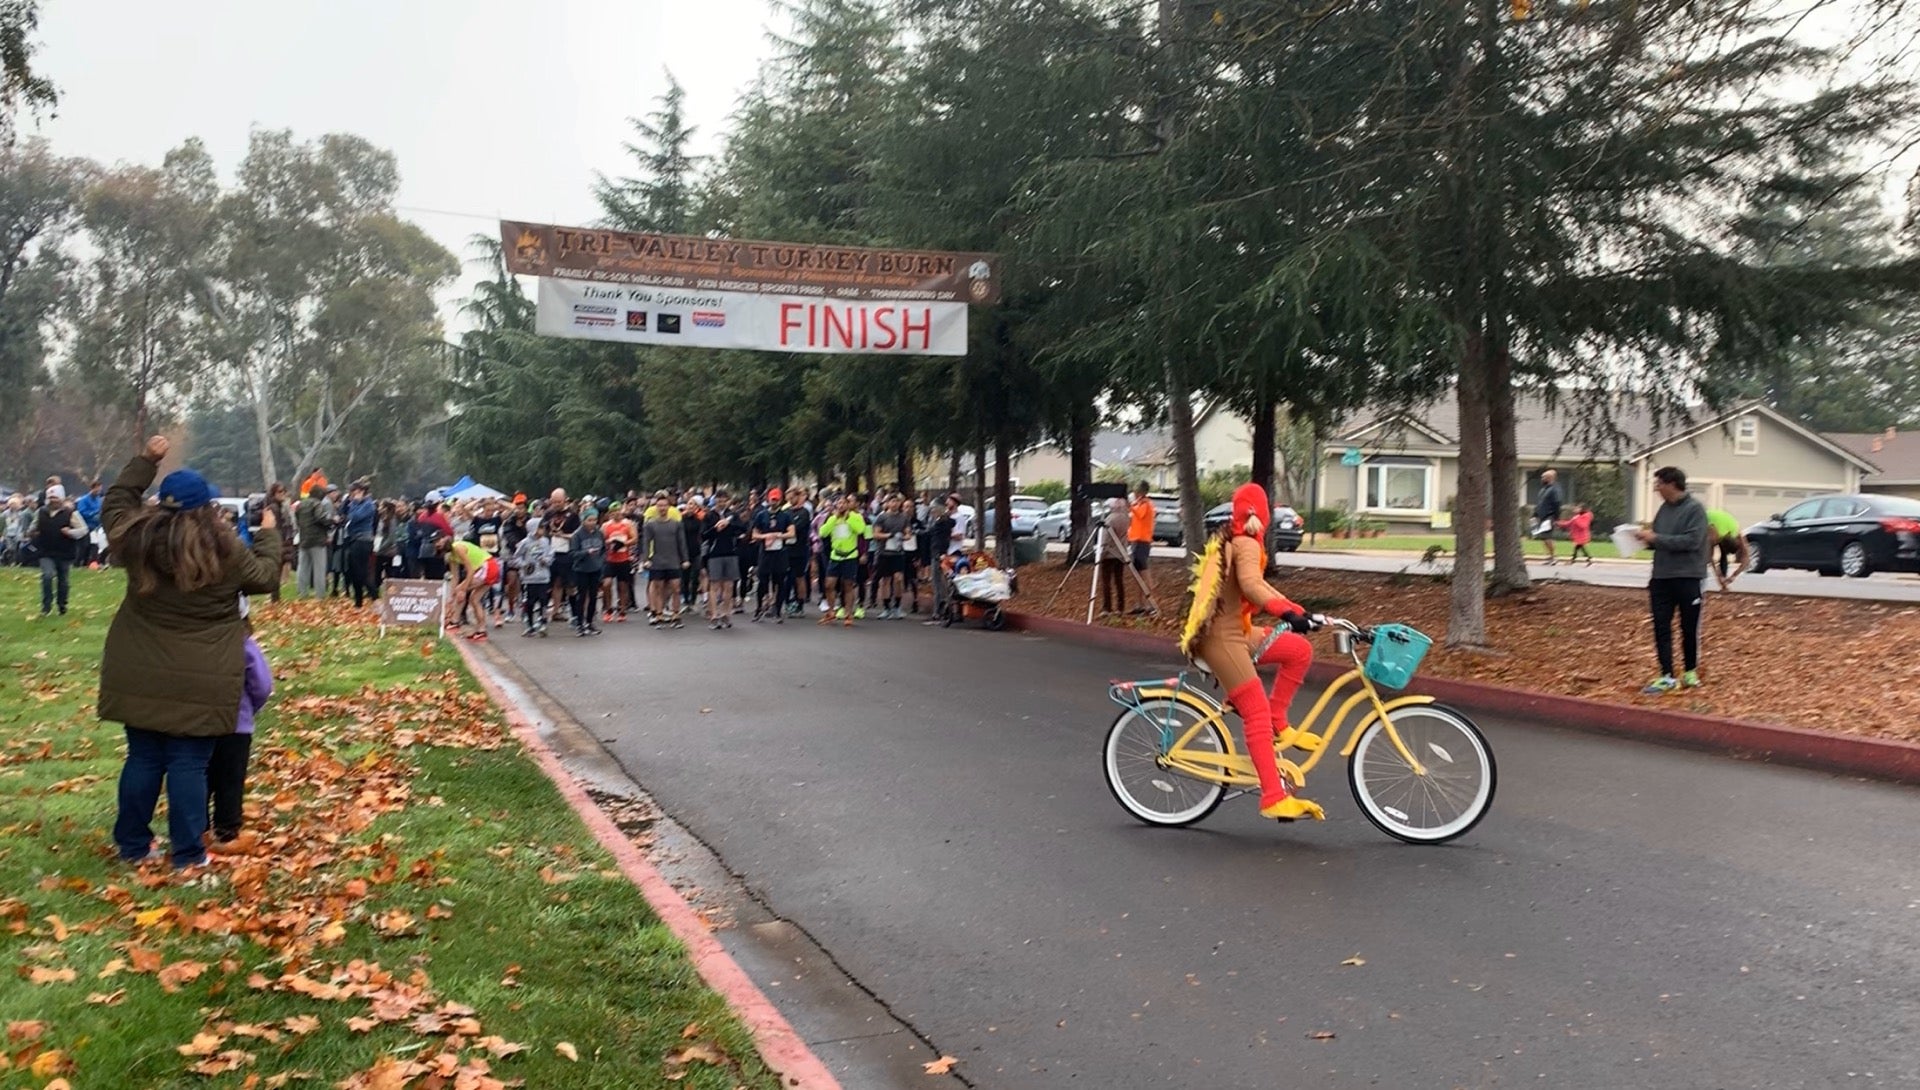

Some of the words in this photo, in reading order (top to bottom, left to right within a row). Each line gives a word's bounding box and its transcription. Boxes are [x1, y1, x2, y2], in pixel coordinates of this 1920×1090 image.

[556, 229, 741, 264] TRI-VALLEY
[751, 246, 868, 272] TURKEY
[879, 254, 955, 275] BURN
[553, 267, 591, 279] FAMILY
[697, 279, 718, 289] KEN
[761, 283, 798, 295] SPORTS
[937, 291, 956, 300] DAY
[583, 285, 622, 299] Thank
[629, 290, 653, 302] You
[655, 292, 723, 308] Sponsors!
[780, 303, 931, 350] FINISH
